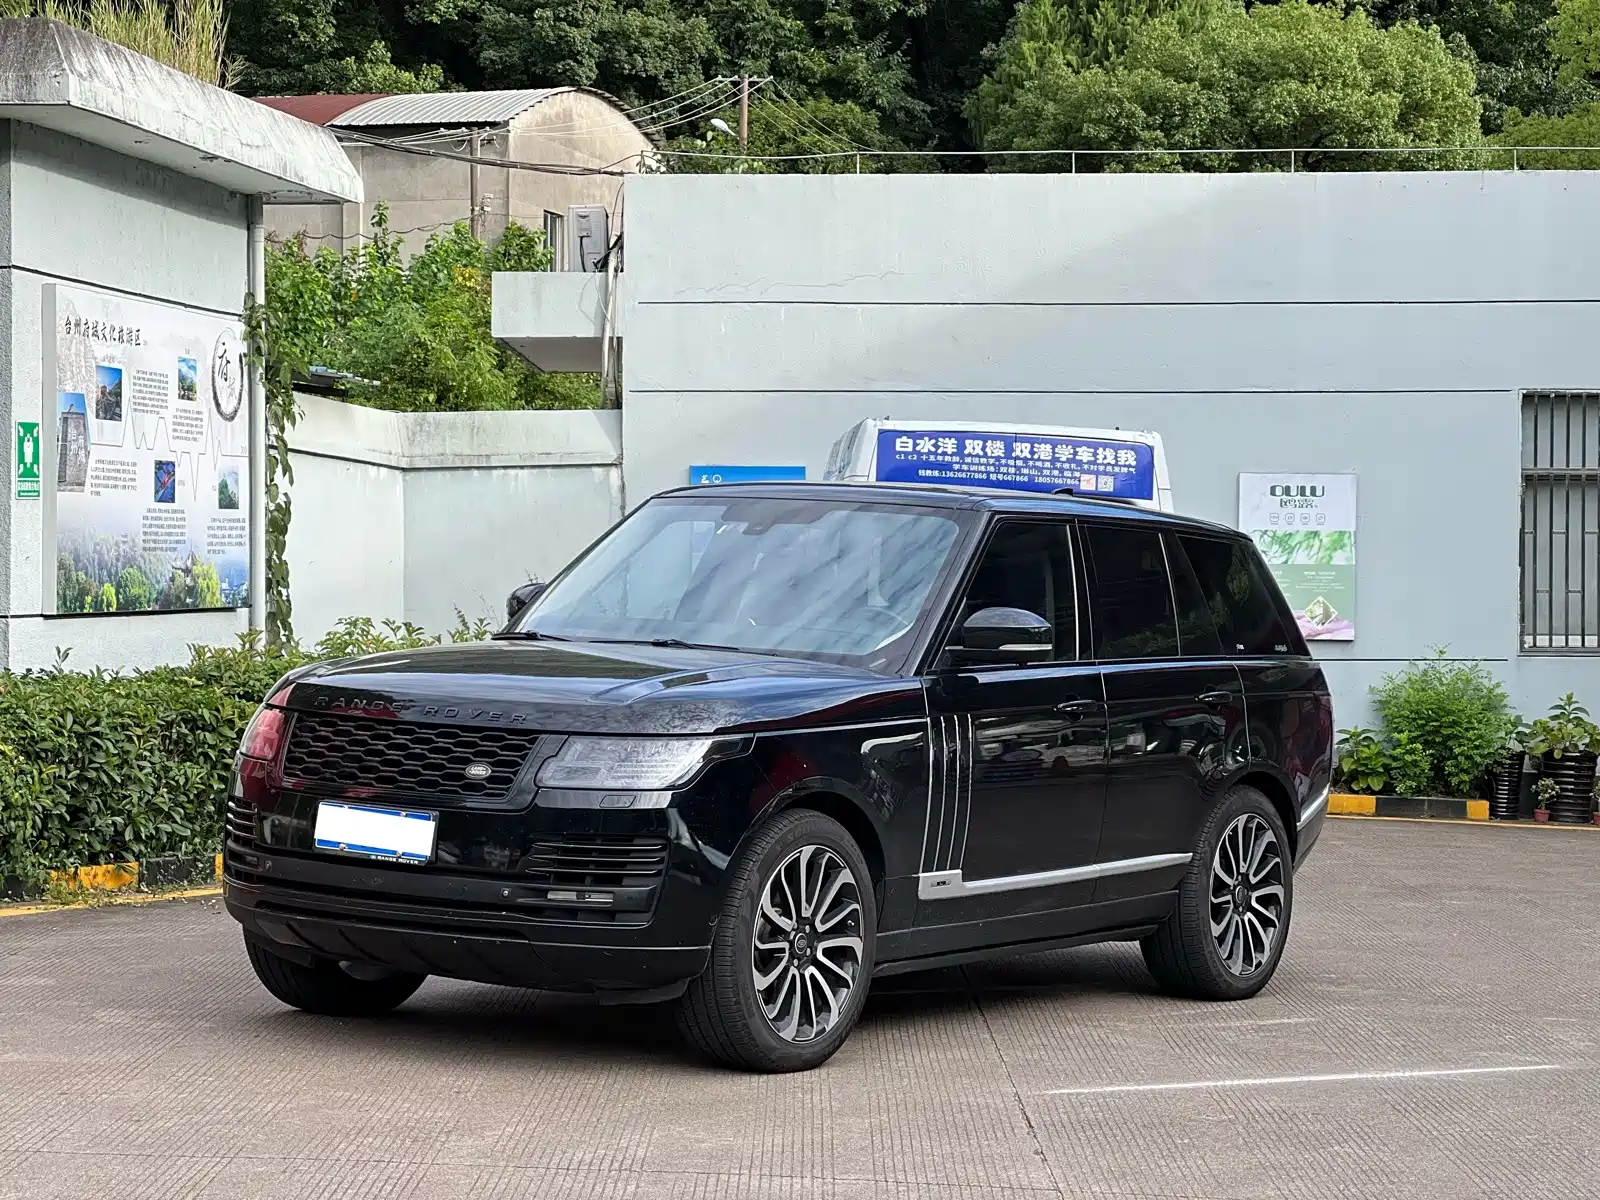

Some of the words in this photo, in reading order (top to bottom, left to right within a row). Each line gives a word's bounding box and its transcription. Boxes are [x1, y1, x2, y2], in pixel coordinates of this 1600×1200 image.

[895, 435, 958, 455] 白水洋
[963, 439, 1005, 458] 双楼
[1011, 442, 1137, 467] 双港学车找我
[1034, 476, 1080, 485] 18057667866
[1270, 485, 1325, 497] OULU
[313, 696, 405, 712] RANGE
[423, 705, 527, 725] ROVER
